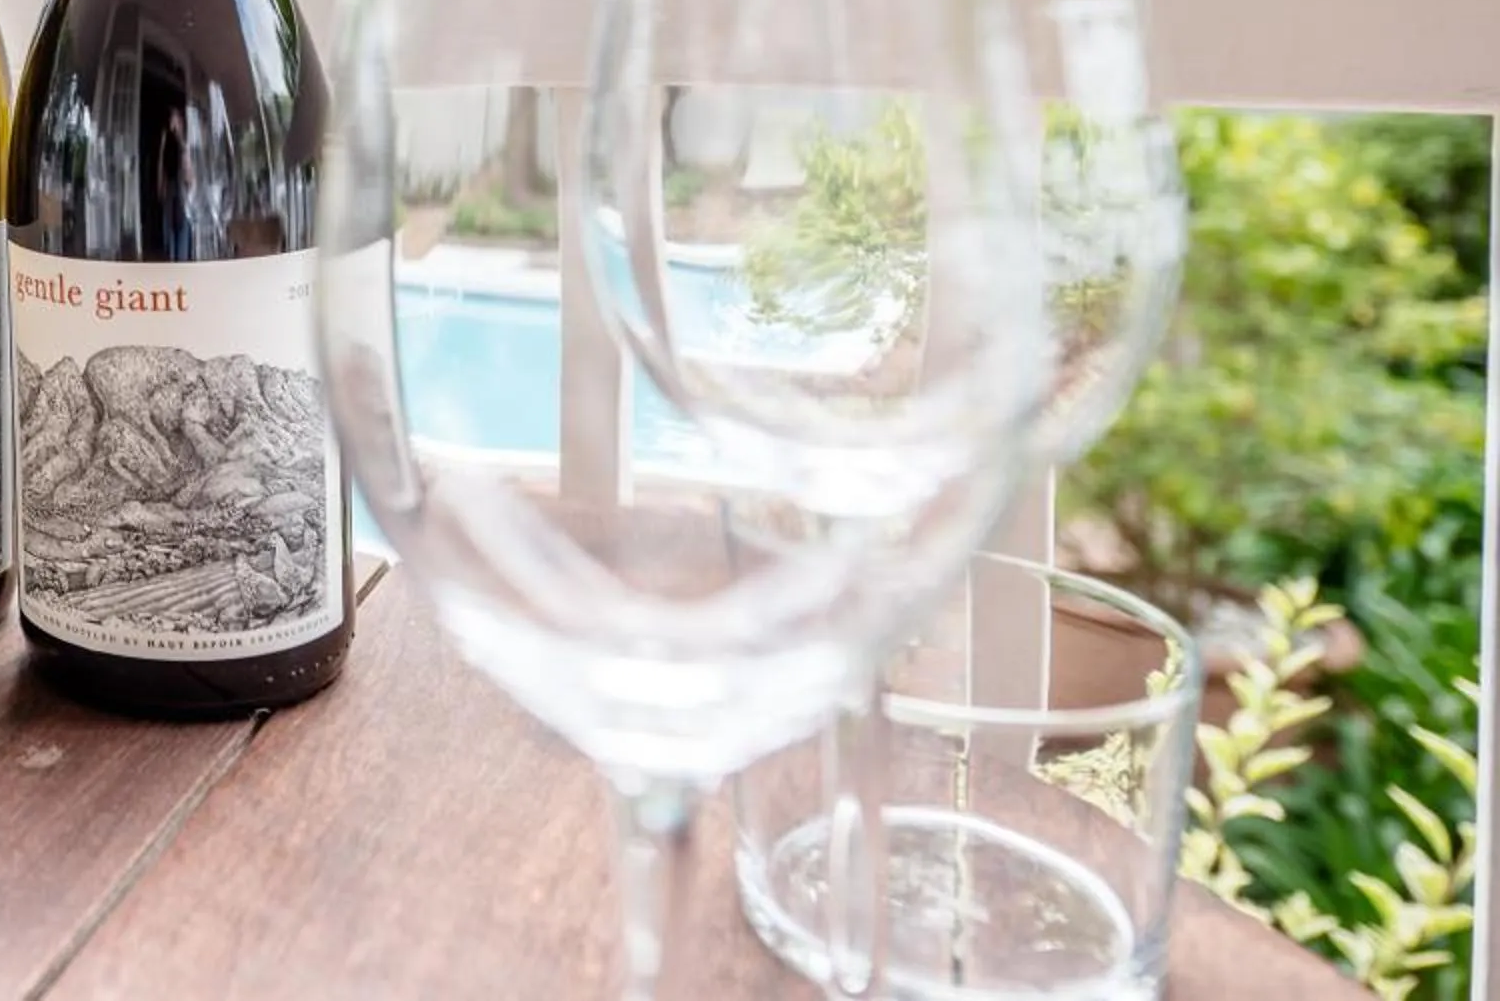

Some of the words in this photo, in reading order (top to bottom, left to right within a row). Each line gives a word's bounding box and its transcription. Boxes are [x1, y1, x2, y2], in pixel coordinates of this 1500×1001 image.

[15, 272, 83, 307] gentle
[95, 278, 189, 320] giant
[146, 639, 184, 651] HAUT
